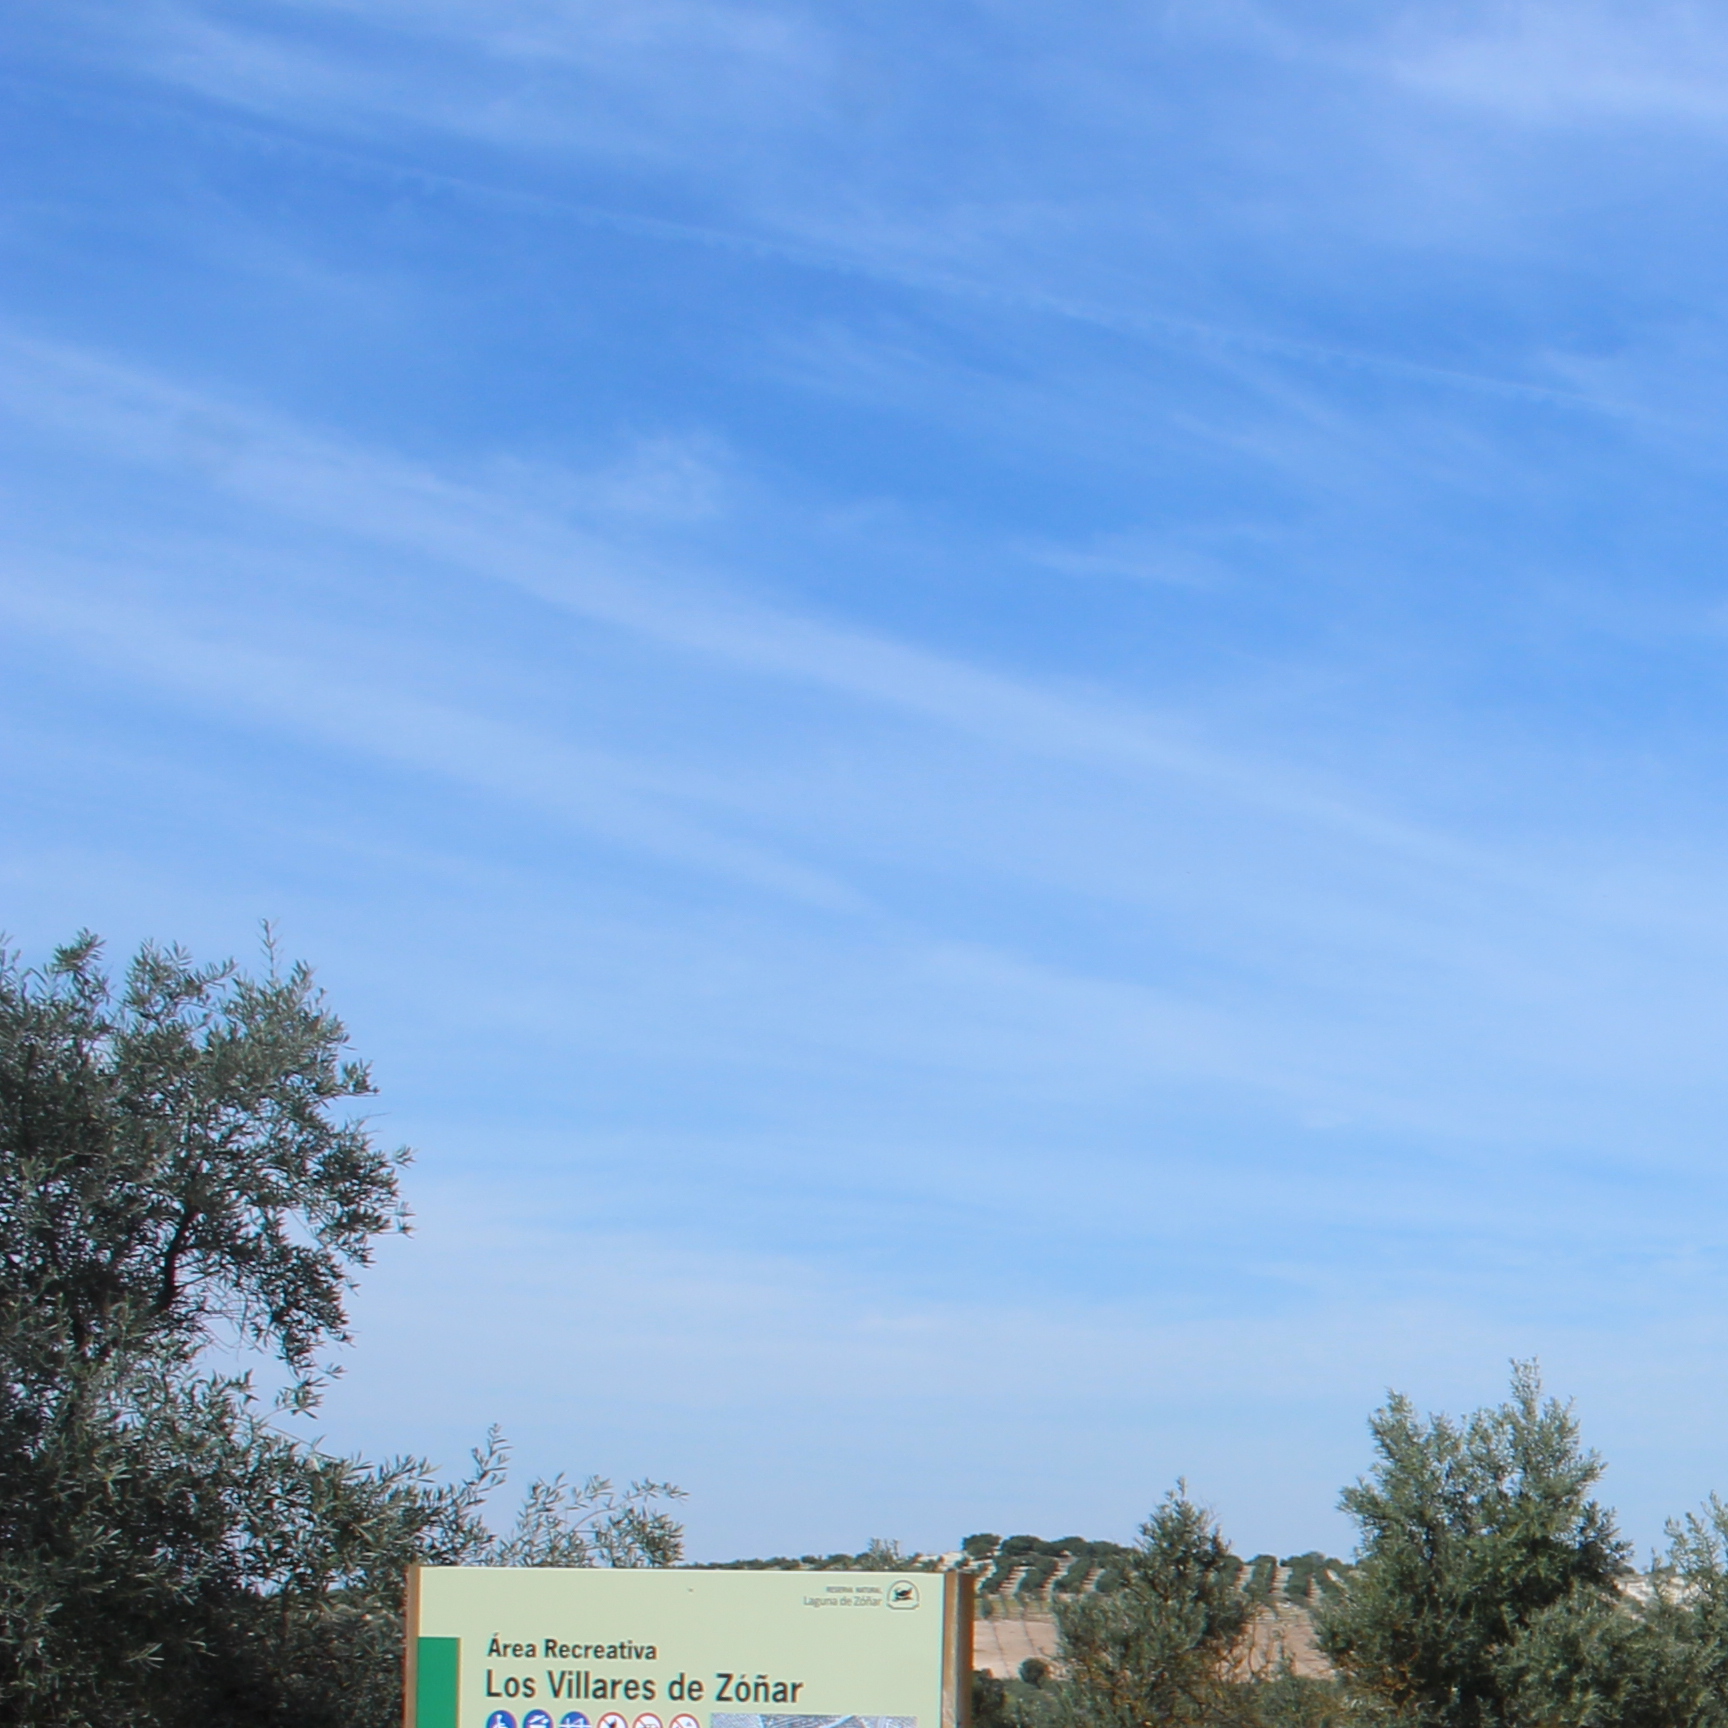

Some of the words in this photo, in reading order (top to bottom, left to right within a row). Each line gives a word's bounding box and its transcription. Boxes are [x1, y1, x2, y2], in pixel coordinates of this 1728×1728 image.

[803, 1596, 838, 1608] Laguna
[840, 1596, 851, 1606] de
[487, 1633, 536, 1658] Área
[544, 1639, 656, 1660] Recreativa
[486, 1669, 535, 1698] Los
[547, 1670, 655, 1700] Villares
[668, 1673, 703, 1701] de
[716, 1673, 803, 1703] Zóñar
